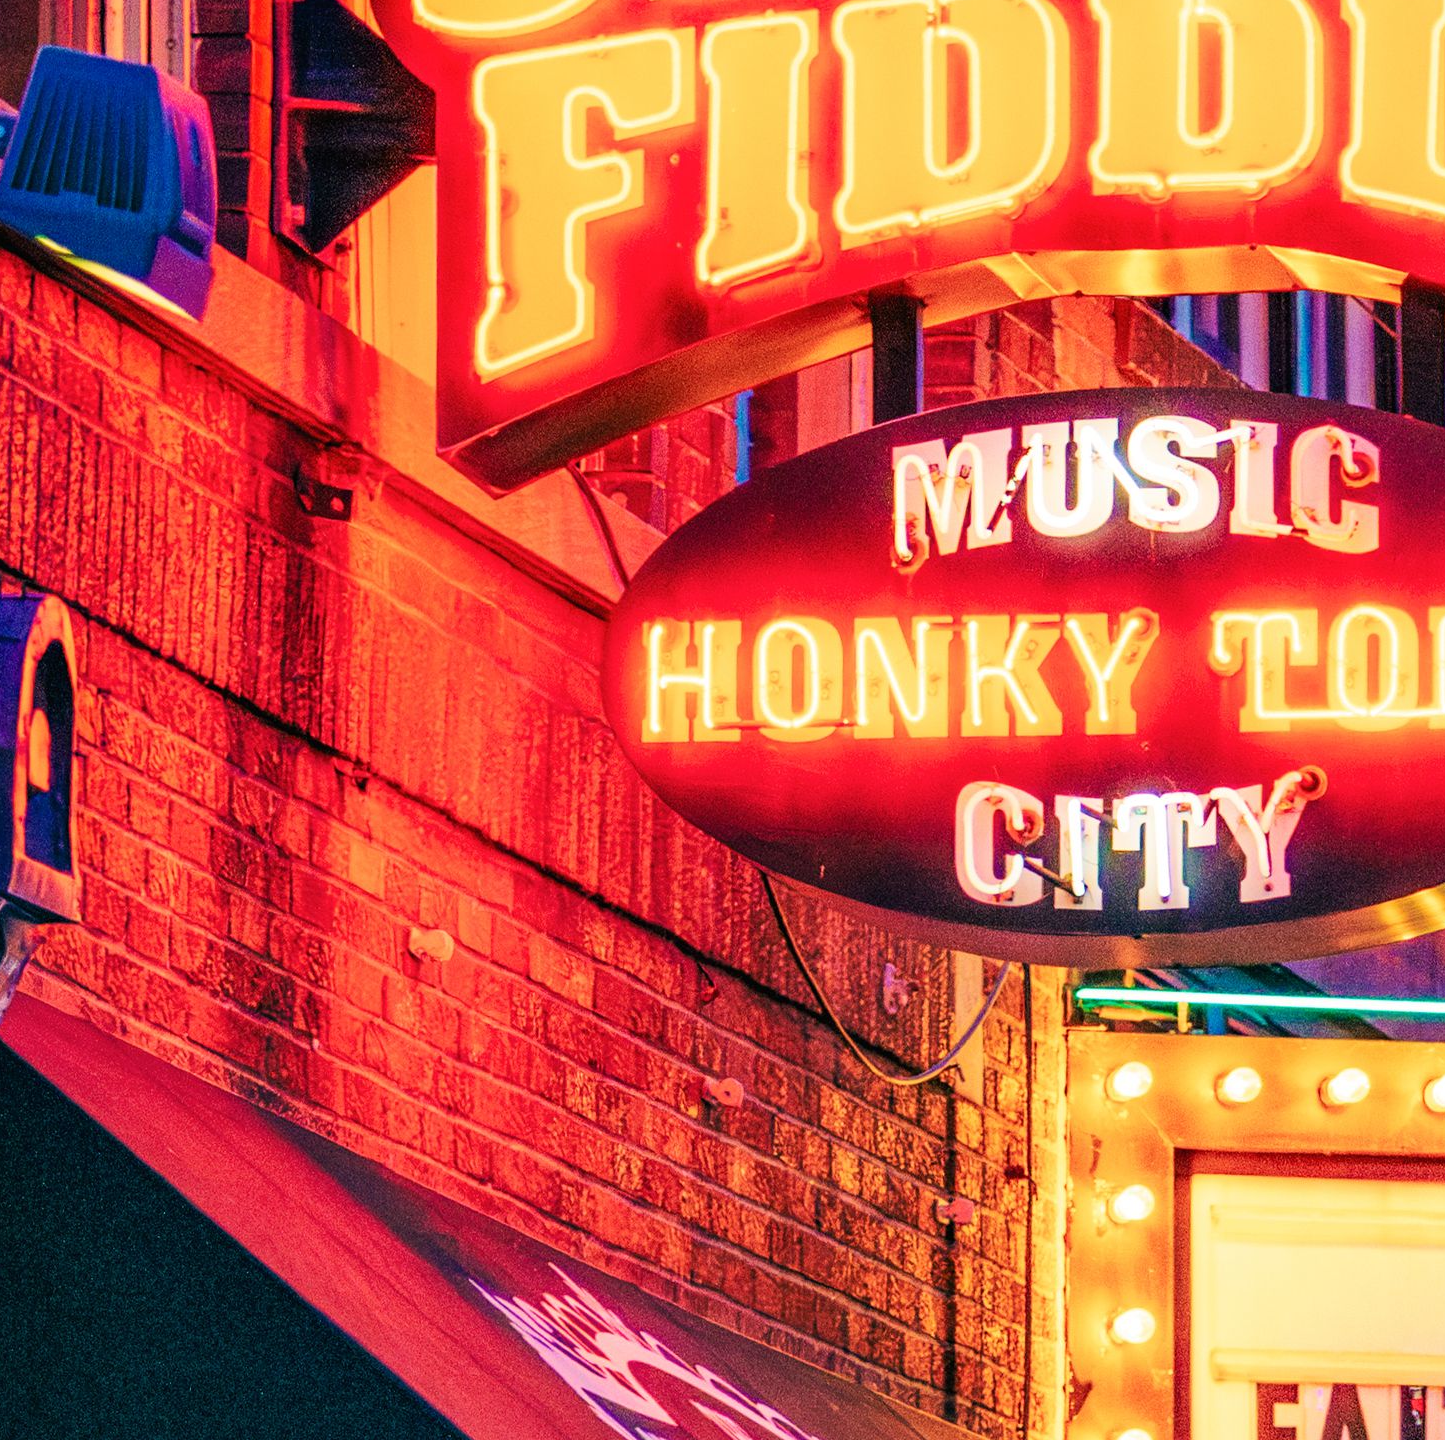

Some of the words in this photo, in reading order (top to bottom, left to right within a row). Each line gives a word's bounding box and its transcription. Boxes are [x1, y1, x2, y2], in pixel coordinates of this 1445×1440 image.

[890, 412, 1382, 570] MUSIC
[641, 608, 1159, 748] HONKY
[955, 768, 1330, 912] CITY
